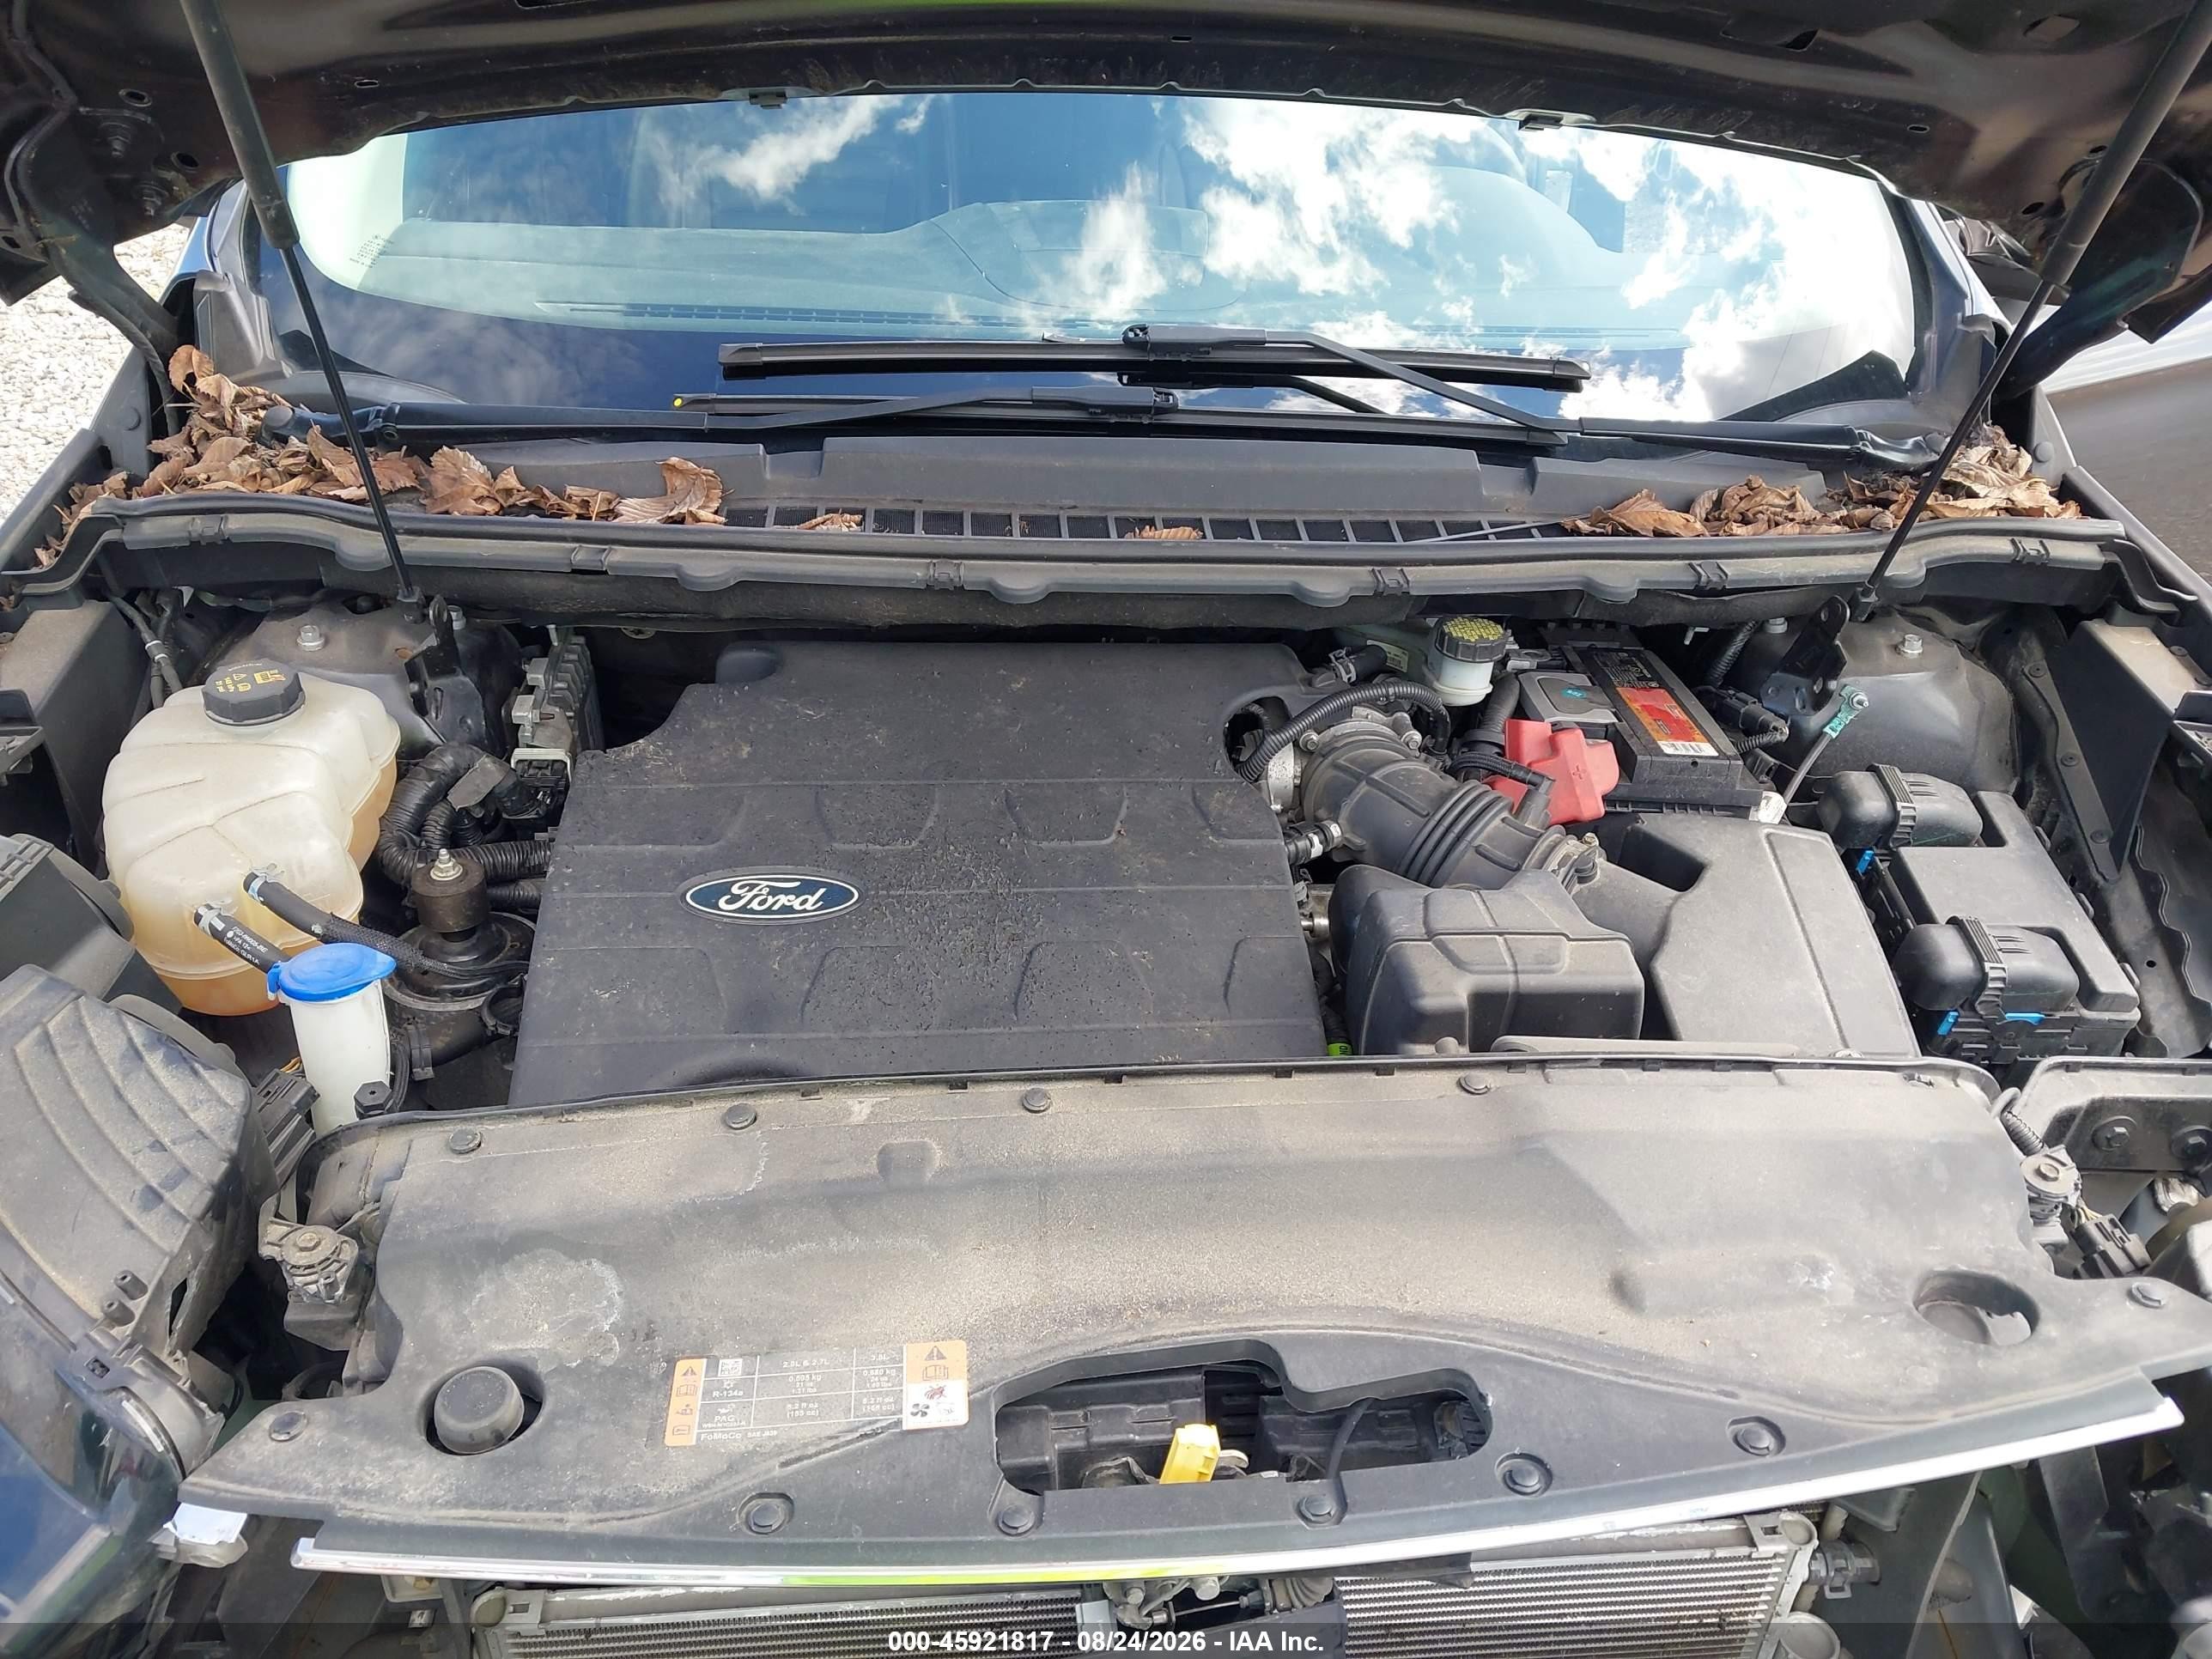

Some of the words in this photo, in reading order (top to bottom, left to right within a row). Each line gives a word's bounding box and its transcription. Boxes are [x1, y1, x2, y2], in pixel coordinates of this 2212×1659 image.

[718, 879, 827, 911] Ford
[885, 1368, 896, 1376] kg
[712, 1389, 744, 1398] R-134a
[701, 1431, 742, 1441] FoMoCo
